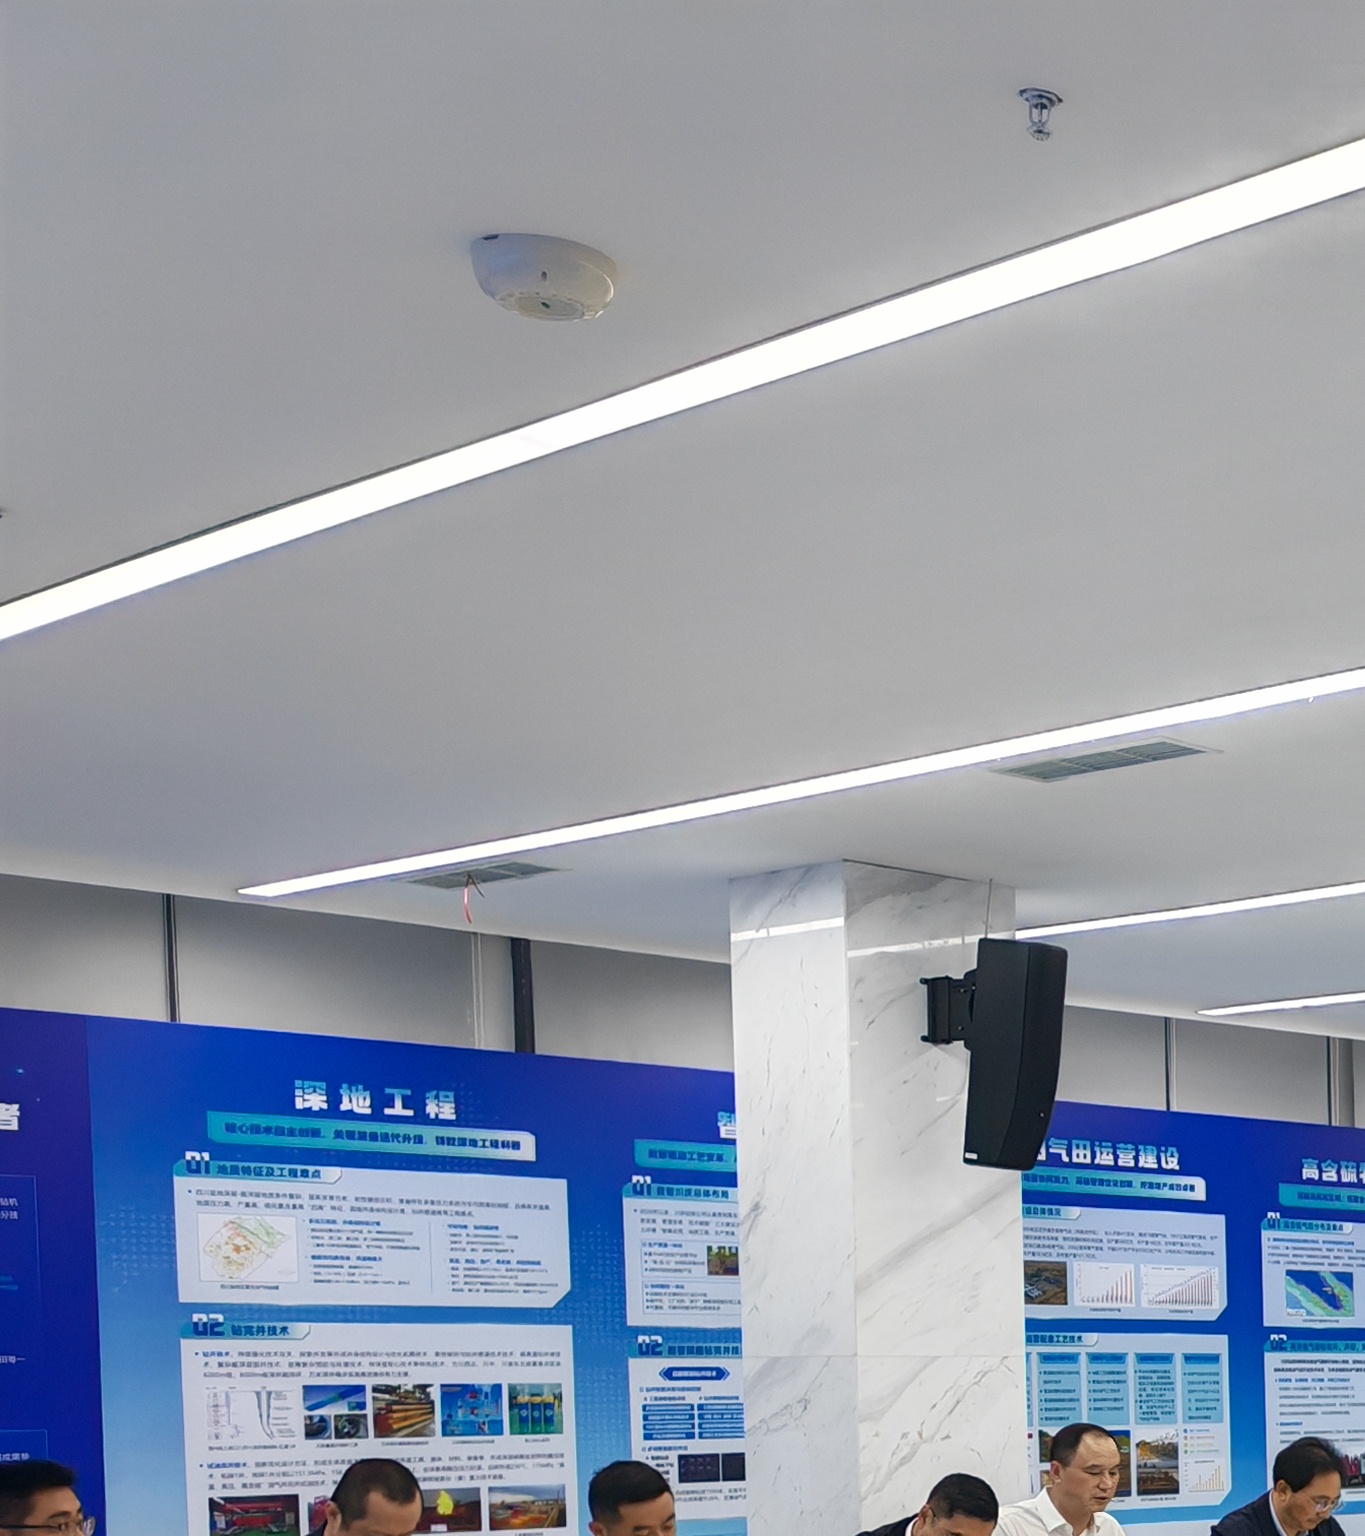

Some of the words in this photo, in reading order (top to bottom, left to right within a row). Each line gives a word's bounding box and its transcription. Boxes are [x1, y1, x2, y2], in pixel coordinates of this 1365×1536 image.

[294, 1079, 457, 1121] 深地工程
[185, 1151, 211, 1175] 01
[192, 1313, 226, 1337] 02
[637, 1335, 663, 1356] 02
